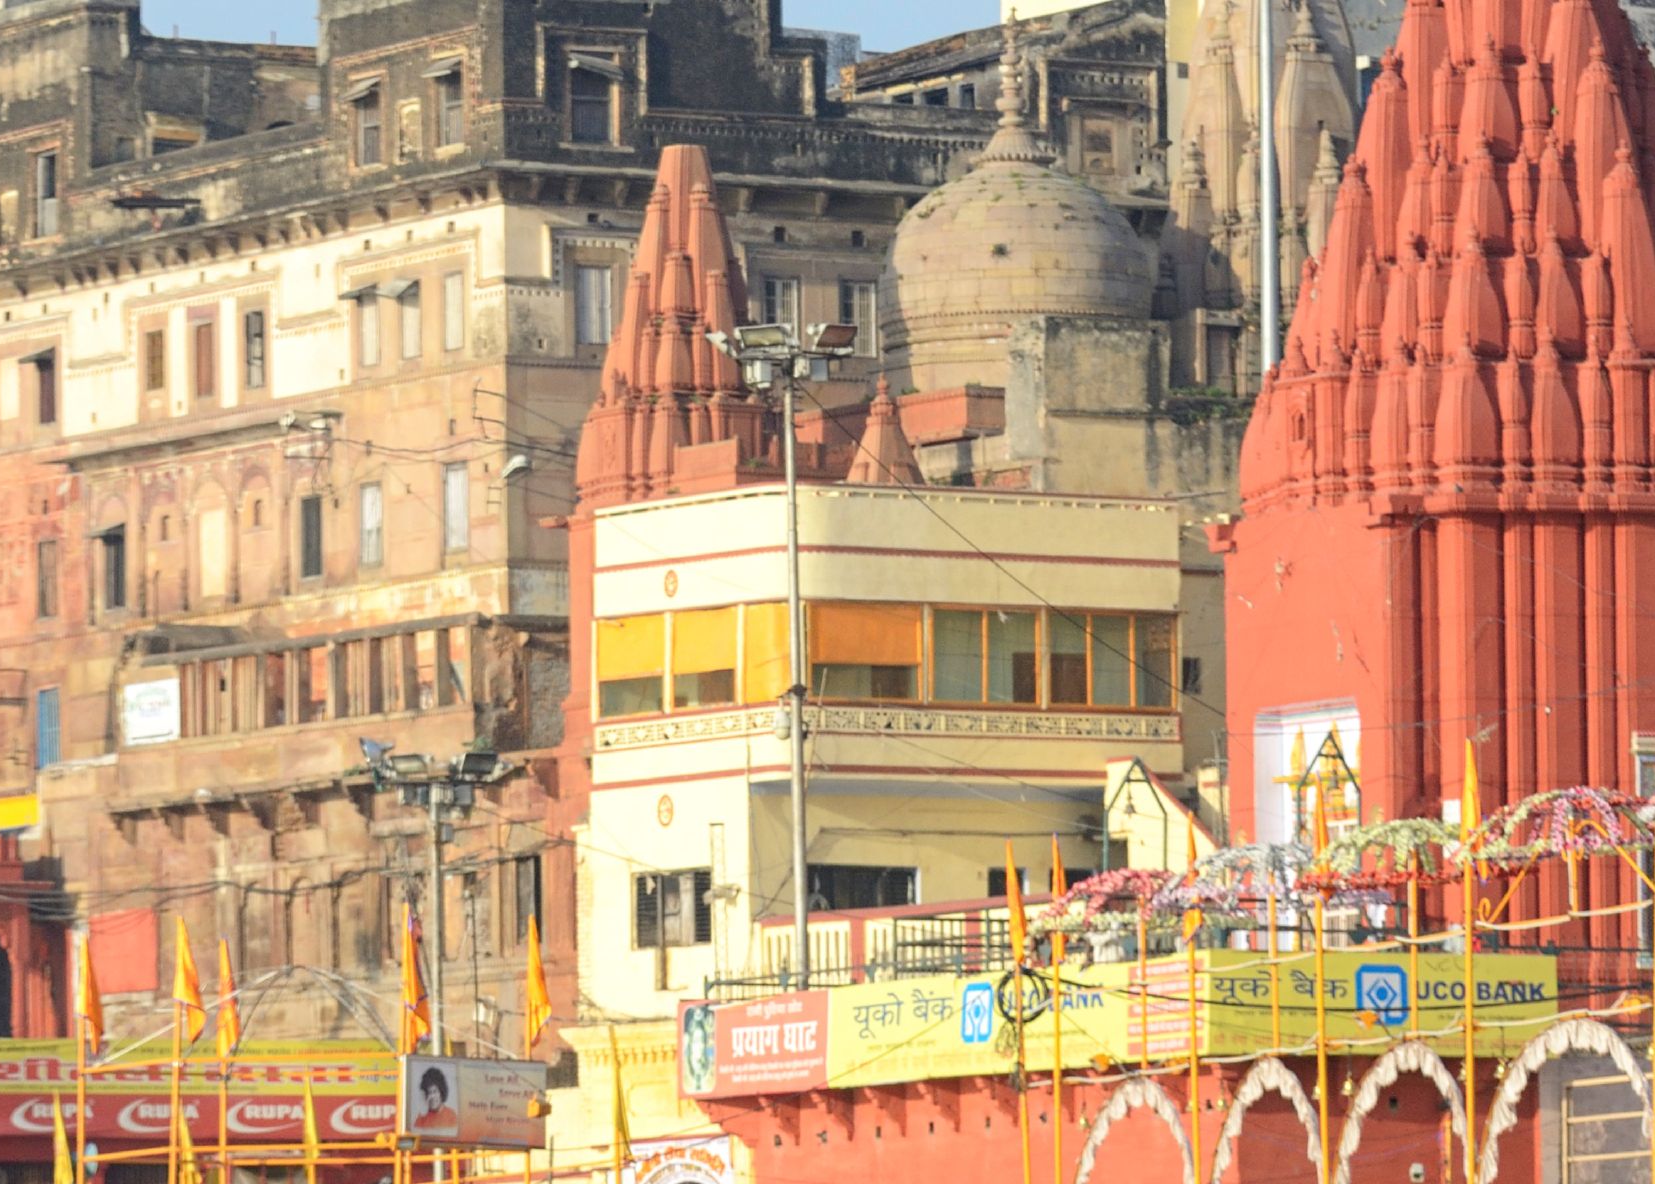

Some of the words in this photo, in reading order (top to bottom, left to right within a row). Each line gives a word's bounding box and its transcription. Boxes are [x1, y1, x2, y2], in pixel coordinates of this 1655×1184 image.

[1417, 981, 1466, 1001] UCO
[1477, 981, 1545, 1002] BANK
[853, 993, 905, 1039] यूको
[911, 989, 955, 1022] बैंक
[731, 1024, 780, 1058] प्रयाग
[783, 1021, 818, 1054] घाट
[137, 1101, 200, 1118] RUA
[244, 1103, 305, 1120] RUPA
[350, 1103, 397, 1120] RUP
